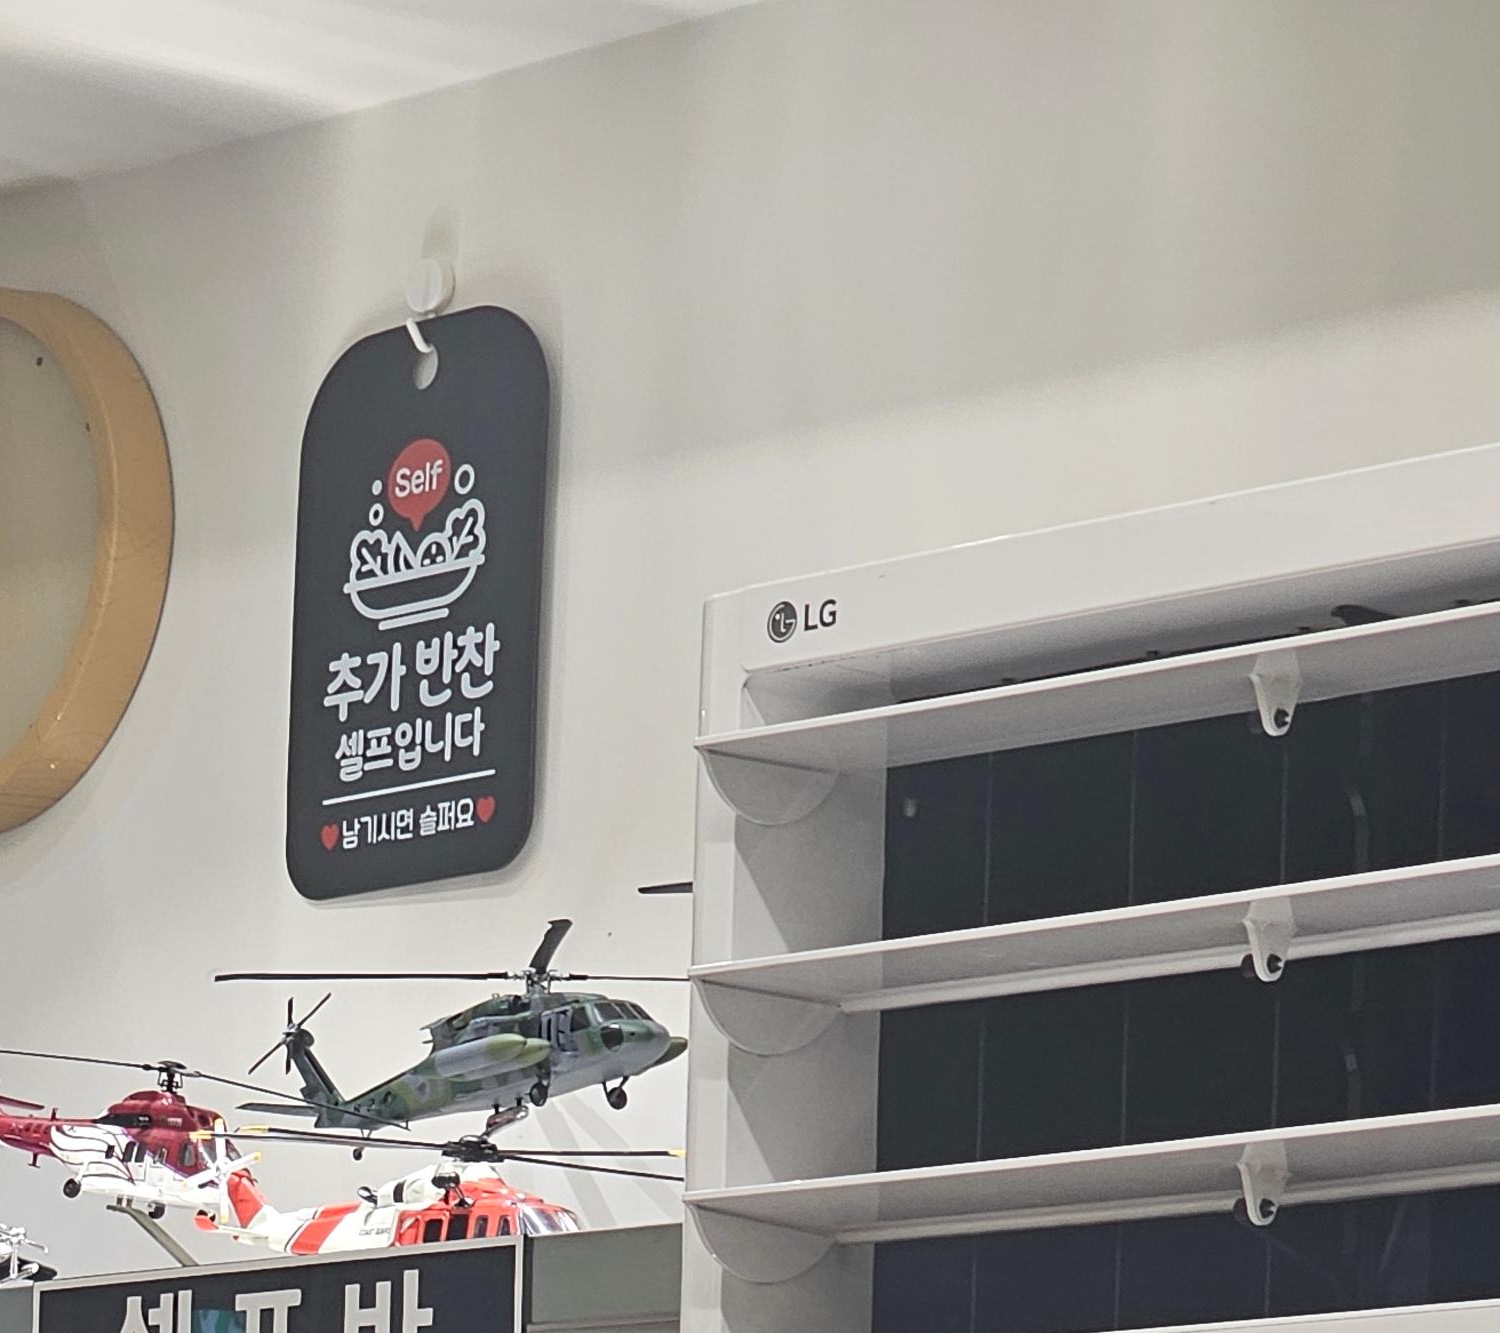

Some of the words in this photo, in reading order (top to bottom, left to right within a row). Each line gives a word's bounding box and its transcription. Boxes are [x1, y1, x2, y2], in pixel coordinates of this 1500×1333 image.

[395, 459, 444, 498] Self
[804, 599, 837, 631] LG
[323, 641, 407, 722] 추가
[415, 622, 500, 707] 반찬
[334, 706, 486, 782] 셀프입니다
[342, 808, 414, 849] 남기시면
[419, 797, 475, 836] 슬퍼요
